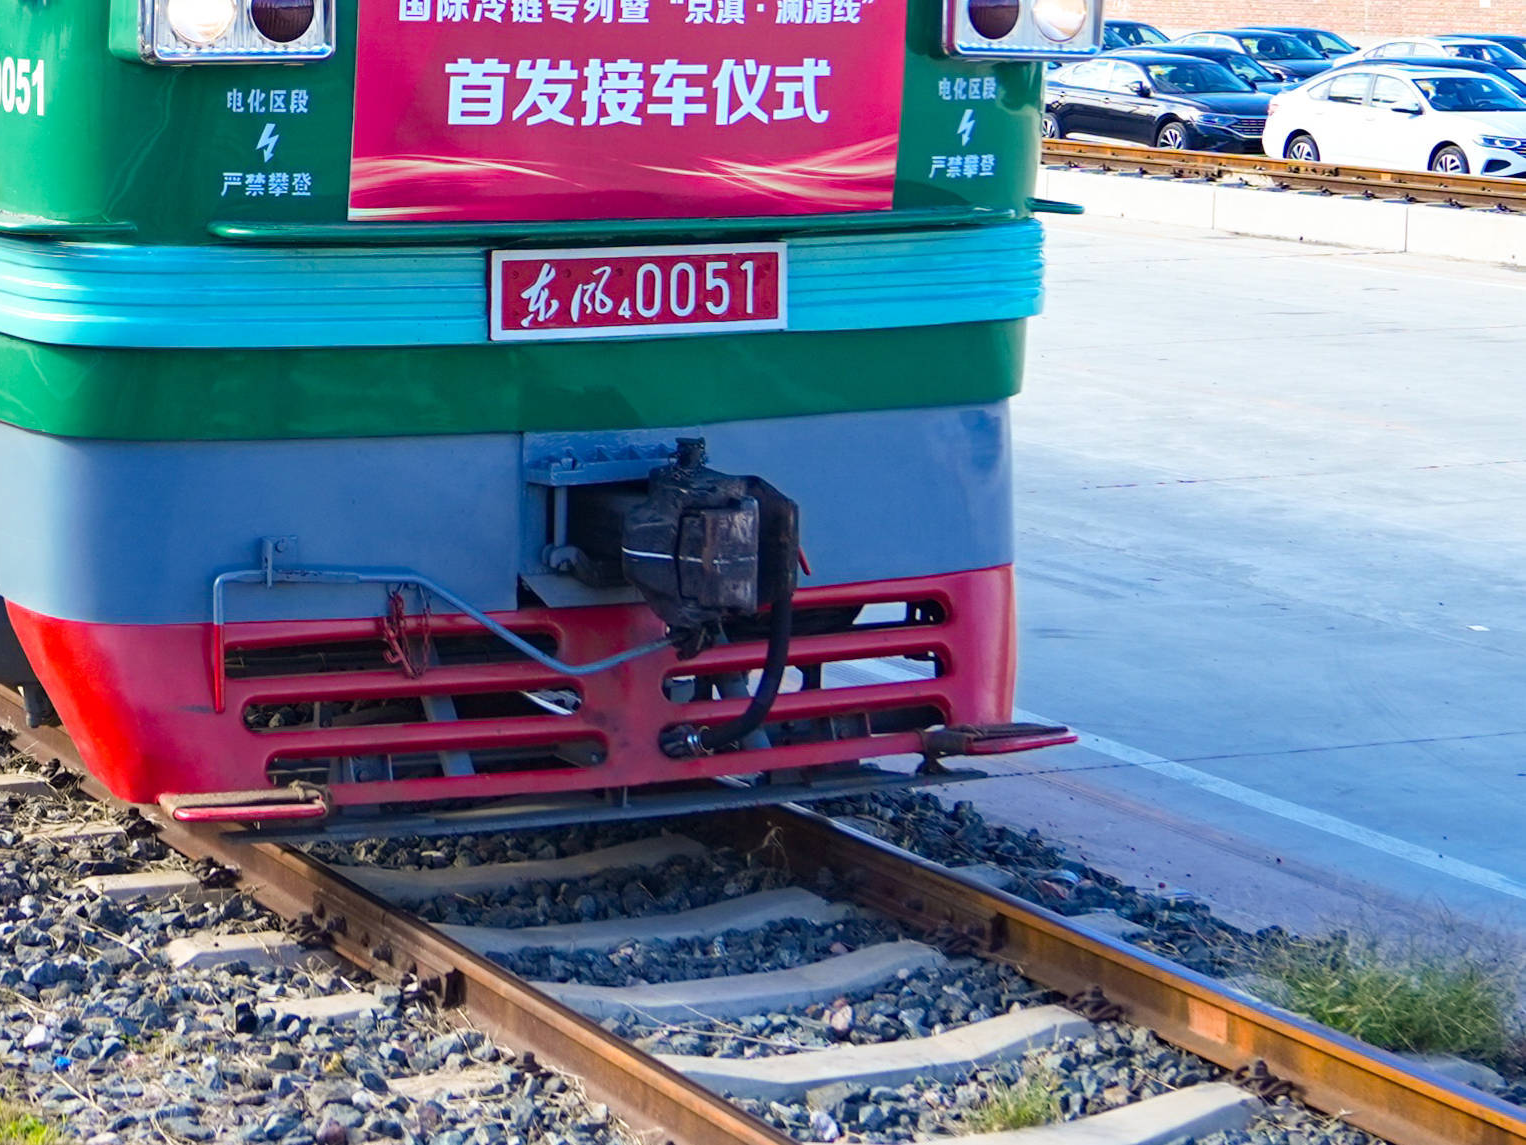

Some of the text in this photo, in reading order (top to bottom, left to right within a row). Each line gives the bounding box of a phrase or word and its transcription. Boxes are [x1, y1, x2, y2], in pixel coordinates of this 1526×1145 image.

[226, 88, 309, 113] 电化区段
[445, 57, 831, 127] 首发接车仪式
[938, 76, 997, 101] 电化区段
[928, 153, 997, 178] 严禁攀登
[220, 172, 312, 197] 严禁攀登
